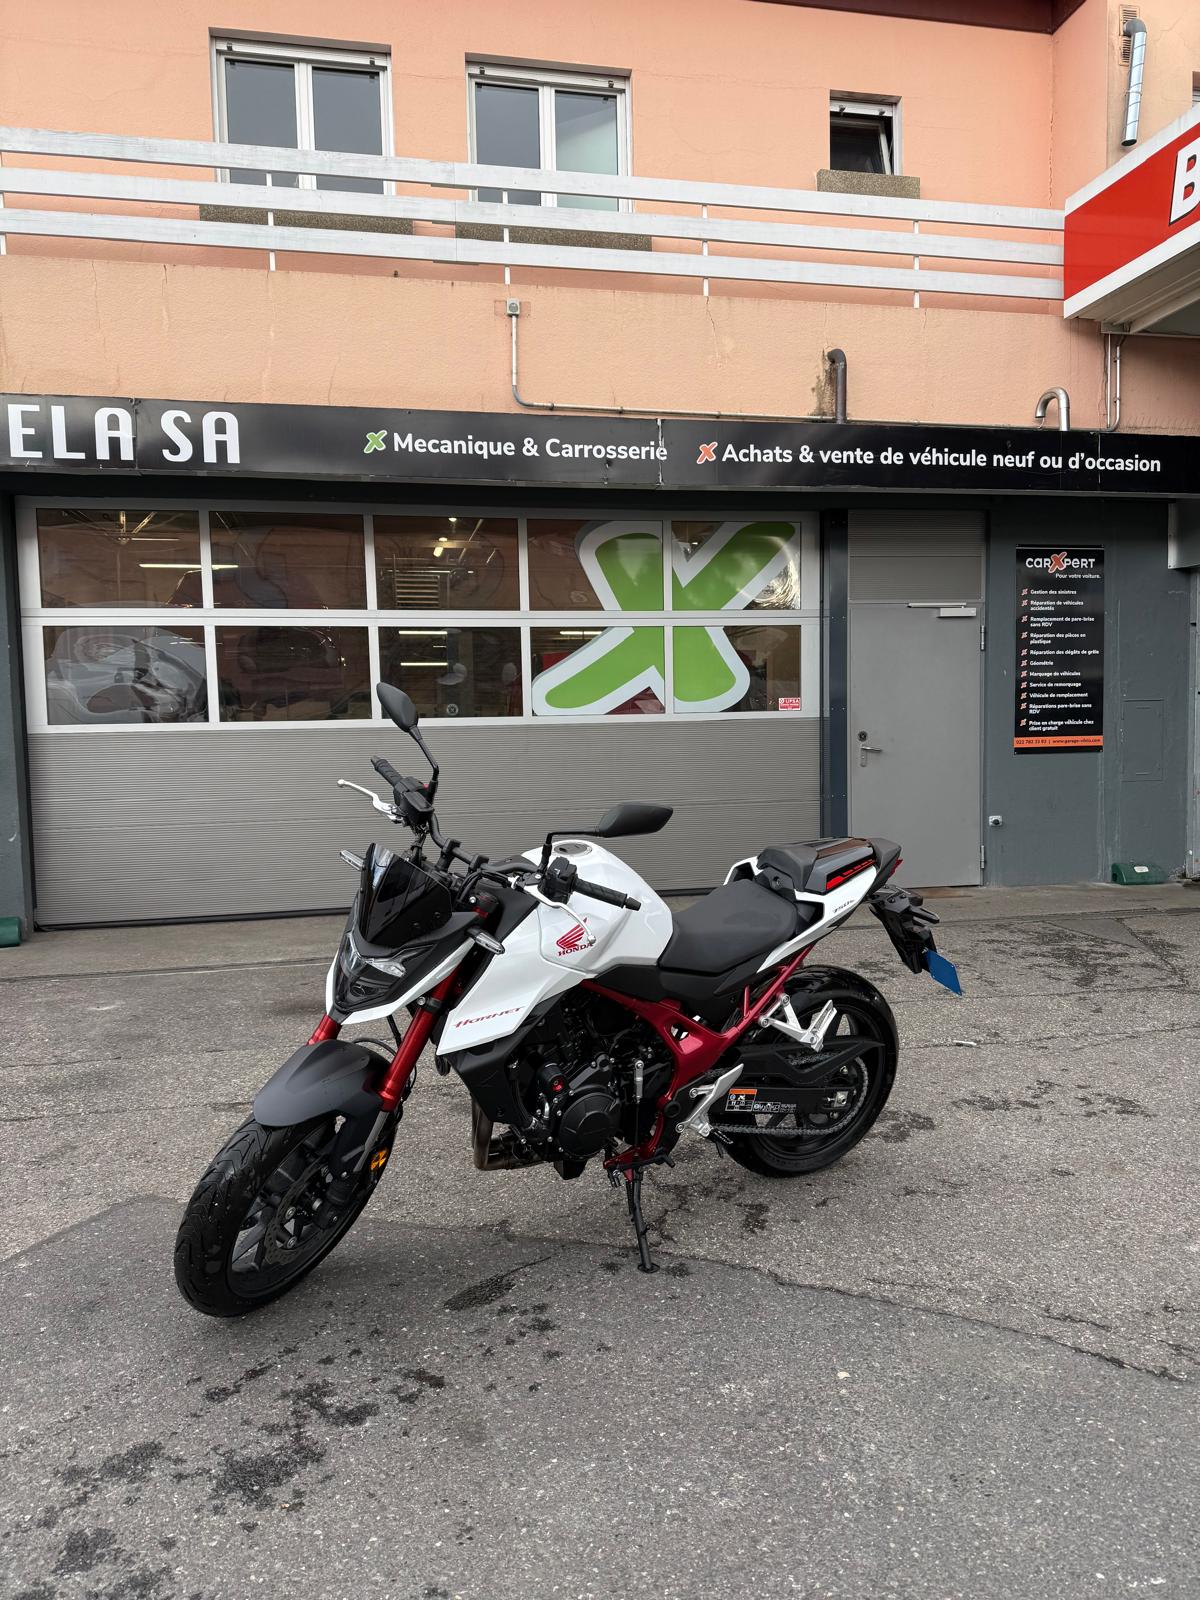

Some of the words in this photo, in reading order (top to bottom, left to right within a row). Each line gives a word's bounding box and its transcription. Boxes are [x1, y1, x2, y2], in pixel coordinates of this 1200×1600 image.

[7, 403, 135, 461] ELA
[160, 410, 241, 464] SA
[393, 433, 515, 459] Mecanique
[522, 437, 540, 457] &
[545, 438, 667, 461] Carrosserie
[722, 444, 793, 463] Achats
[799, 445, 814, 463] &
[819, 447, 874, 464] vente
[880, 448, 904, 465] de
[909, 447, 987, 466] véhicule
[993, 451, 1035, 468] neuf
[1039, 455, 1062, 469] ou
[558, 942, 594, 956] HONDA
